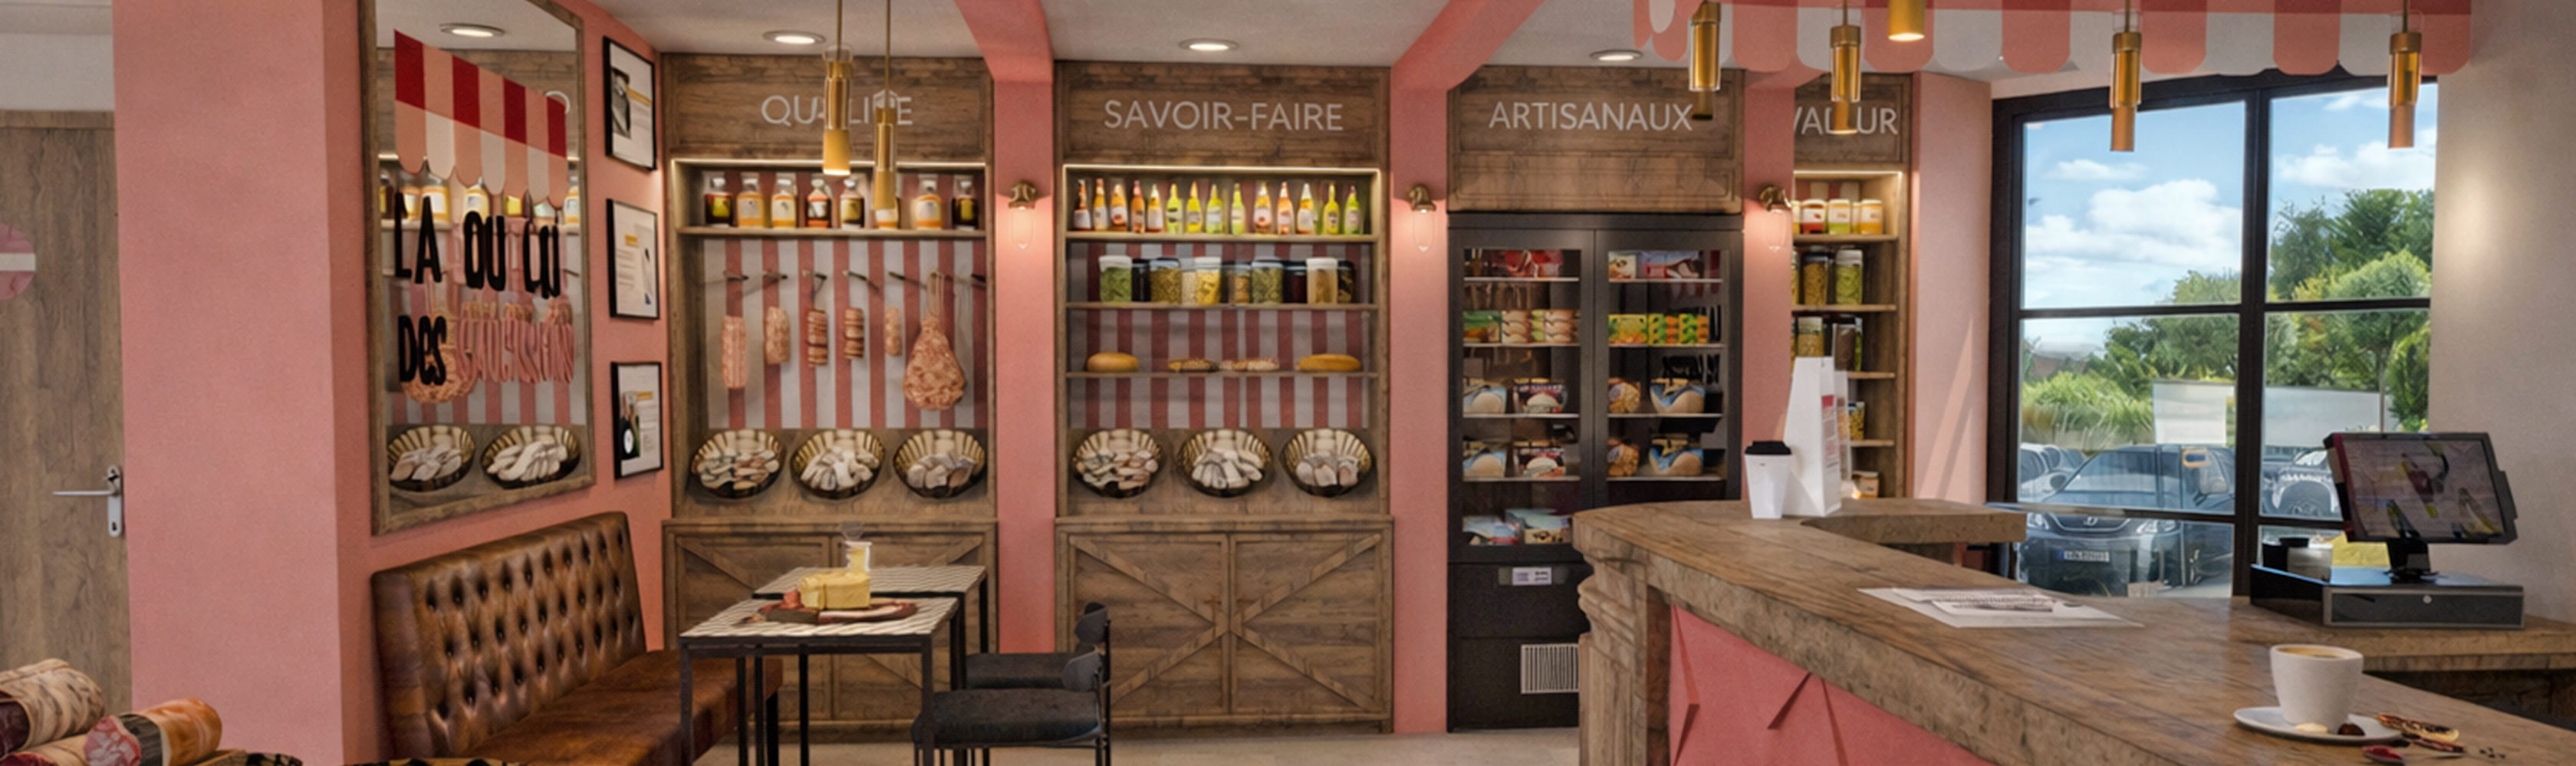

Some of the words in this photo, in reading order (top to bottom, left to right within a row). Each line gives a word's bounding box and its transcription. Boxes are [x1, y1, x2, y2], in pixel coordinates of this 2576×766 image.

[762, 94, 913, 126] QULIE
[1104, 100, 1344, 131] SAVOIR-FAIRE
[1489, 101, 1693, 131] ARTISANAUX
[1793, 106, 1899, 135] ALUR
